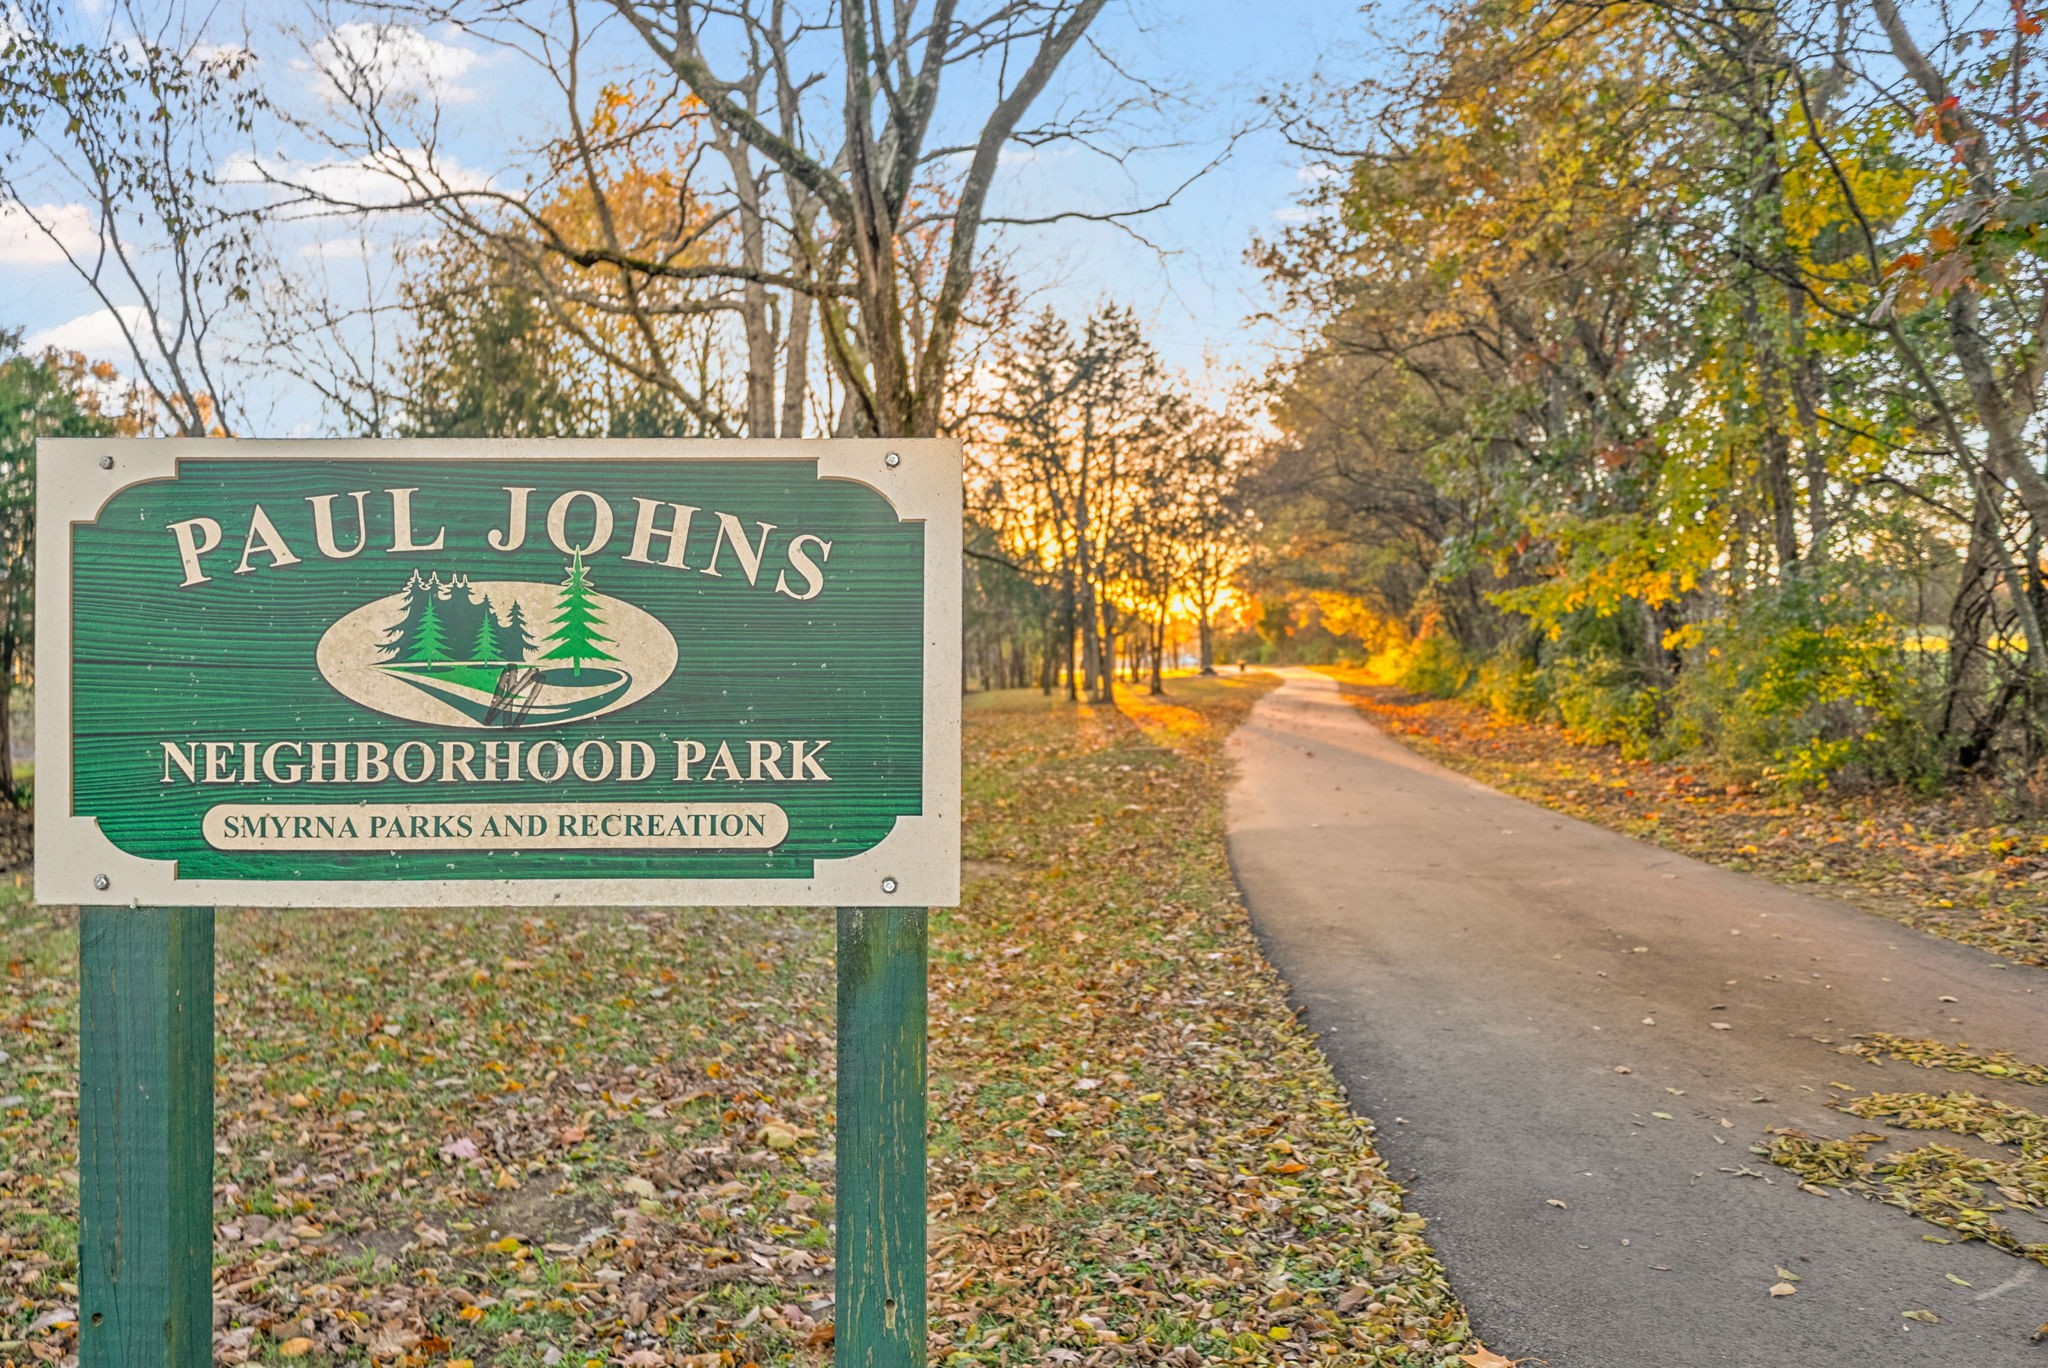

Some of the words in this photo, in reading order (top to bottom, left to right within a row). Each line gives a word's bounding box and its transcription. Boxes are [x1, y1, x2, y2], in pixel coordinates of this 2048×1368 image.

[166, 486, 447, 588] PAUL
[487, 485, 833, 601] JOHNS
[159, 739, 658, 786] NEIGHBORHOOD
[673, 738, 832, 783] PARK
[223, 816, 359, 839] SMYRNA
[369, 816, 474, 838] PARKS
[480, 815, 549, 837] AND
[556, 814, 766, 838] RECREATION
